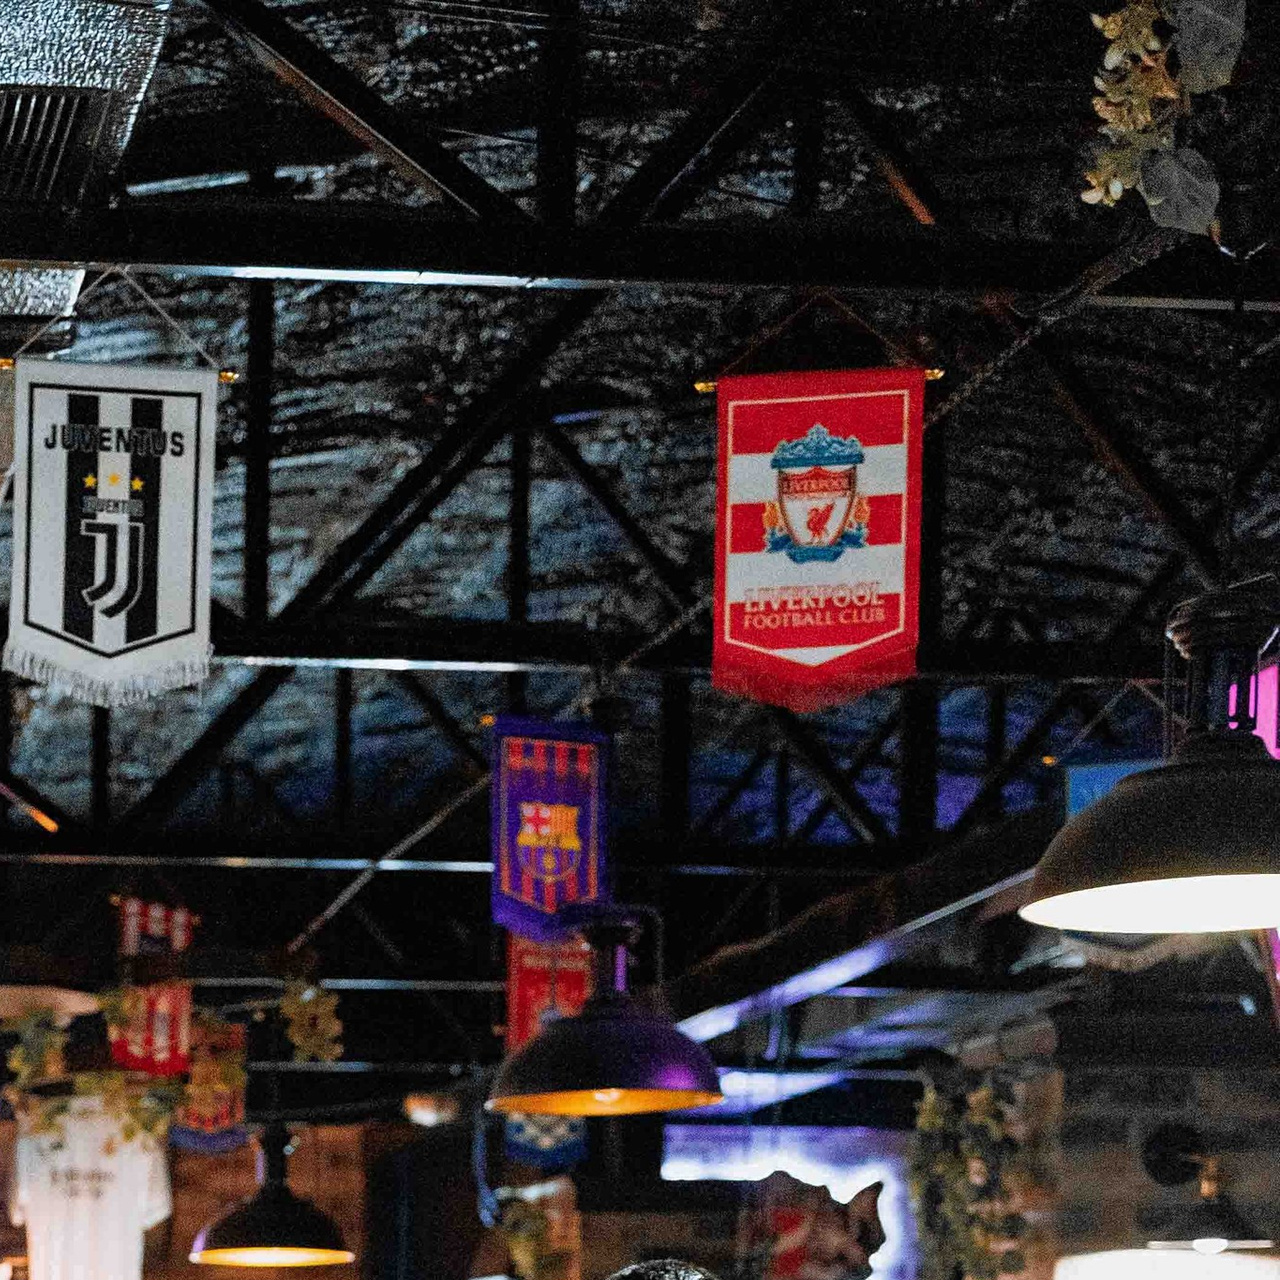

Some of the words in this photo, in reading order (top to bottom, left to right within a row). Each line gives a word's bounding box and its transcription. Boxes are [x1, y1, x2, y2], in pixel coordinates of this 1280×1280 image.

[44, 424, 186, 457] JUVENTUS
[744, 582, 885, 613] LIVERPOOL
[743, 611, 833, 630] FOOTBALL
[838, 606, 886, 624] CLUB
